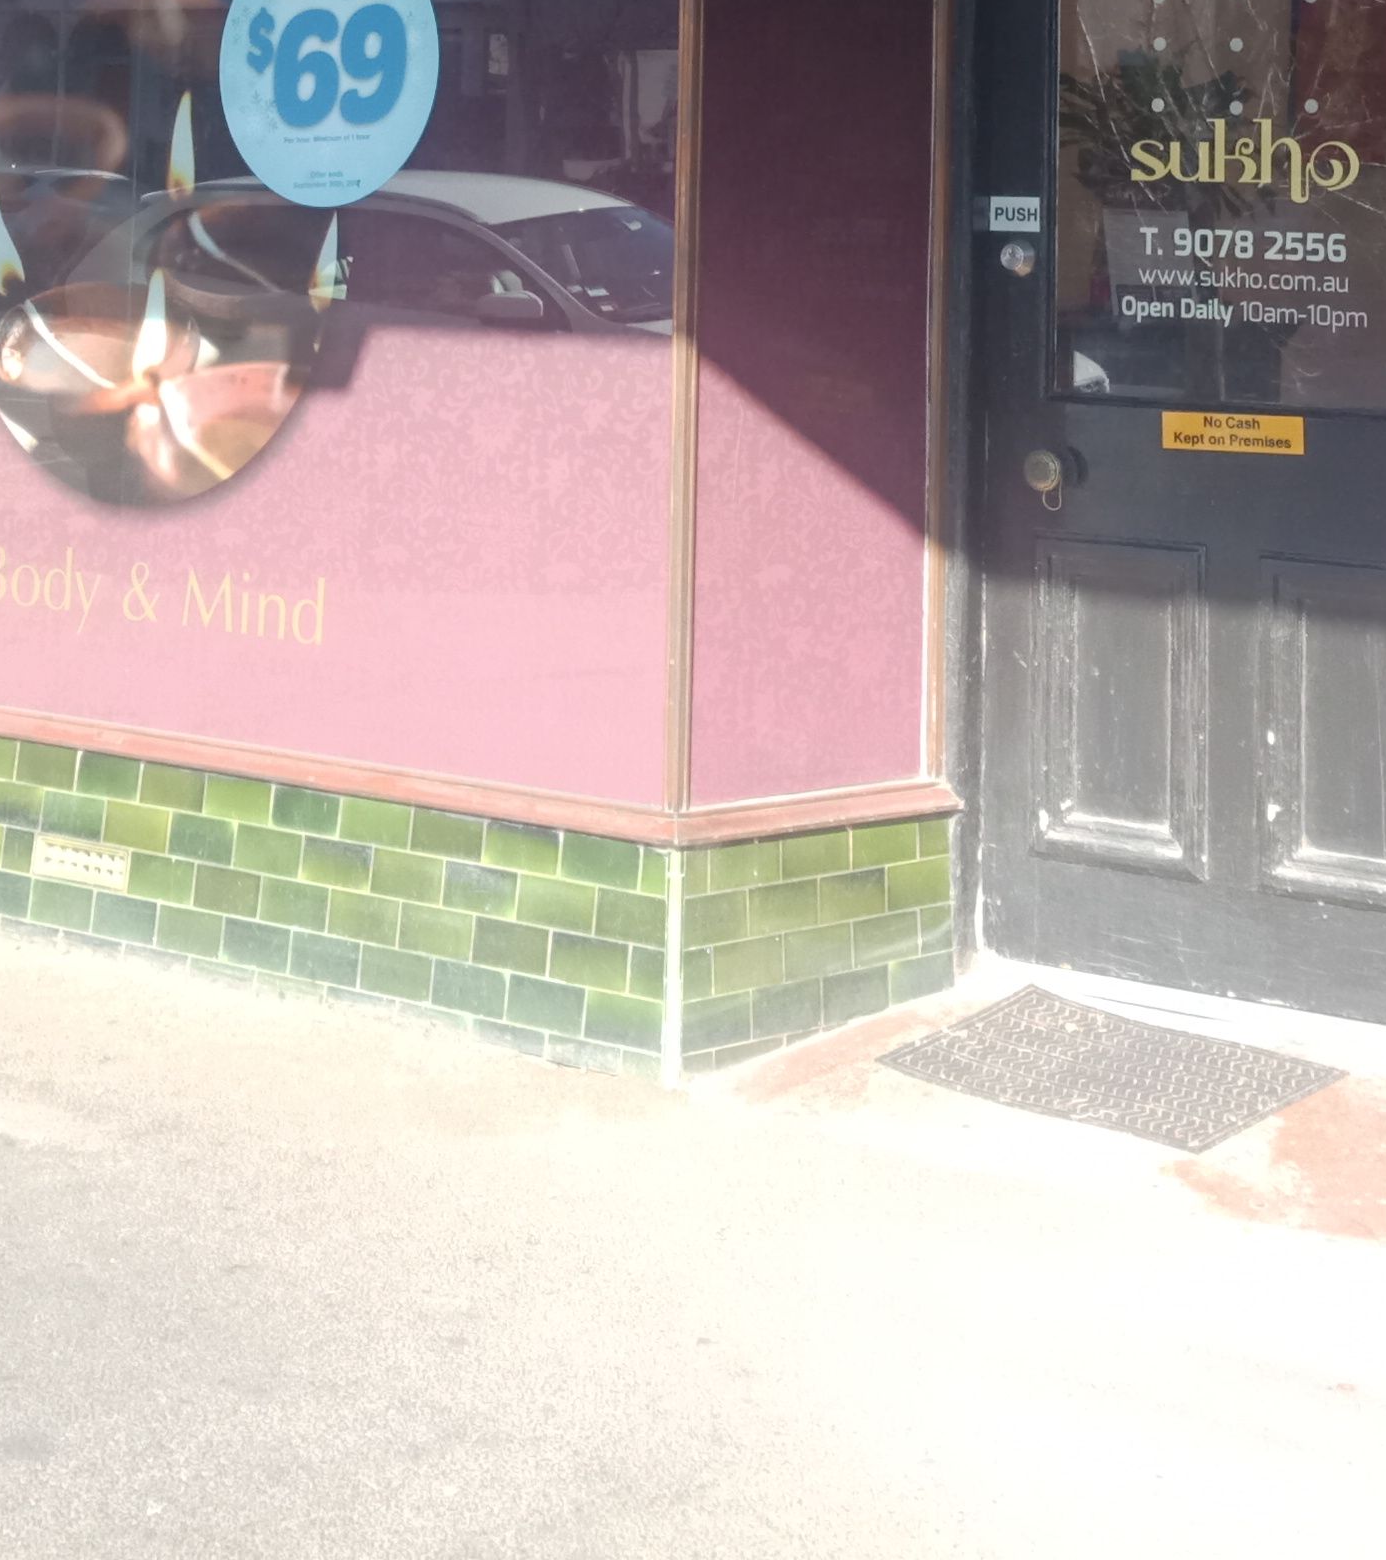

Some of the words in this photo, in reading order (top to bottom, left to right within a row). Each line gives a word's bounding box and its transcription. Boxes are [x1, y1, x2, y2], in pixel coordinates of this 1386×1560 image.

[246, 3, 408, 128] $69
[1130, 118, 1360, 203] sukho
[994, 206, 1038, 222] PUSH
[1139, 227, 1163, 256] T.
[1173, 228, 1254, 258] 9078
[1263, 230, 1347, 263] 2556
[1138, 266, 1349, 293] www.sukho.com.au
[1121, 295, 1175, 323] Open
[1180, 298, 1234, 328] Daily
[1239, 301, 1368, 333] 10am-10pm
[1173, 431, 1205, 447] Kept
[1208, 435, 1225, 445] on
[1229, 434, 1292, 449] Premises
[1203, 416, 1222, 428] No
[1225, 416, 1260, 430] Cash
[122, 561, 160, 622] &
[181, 567, 326, 645] Mind
